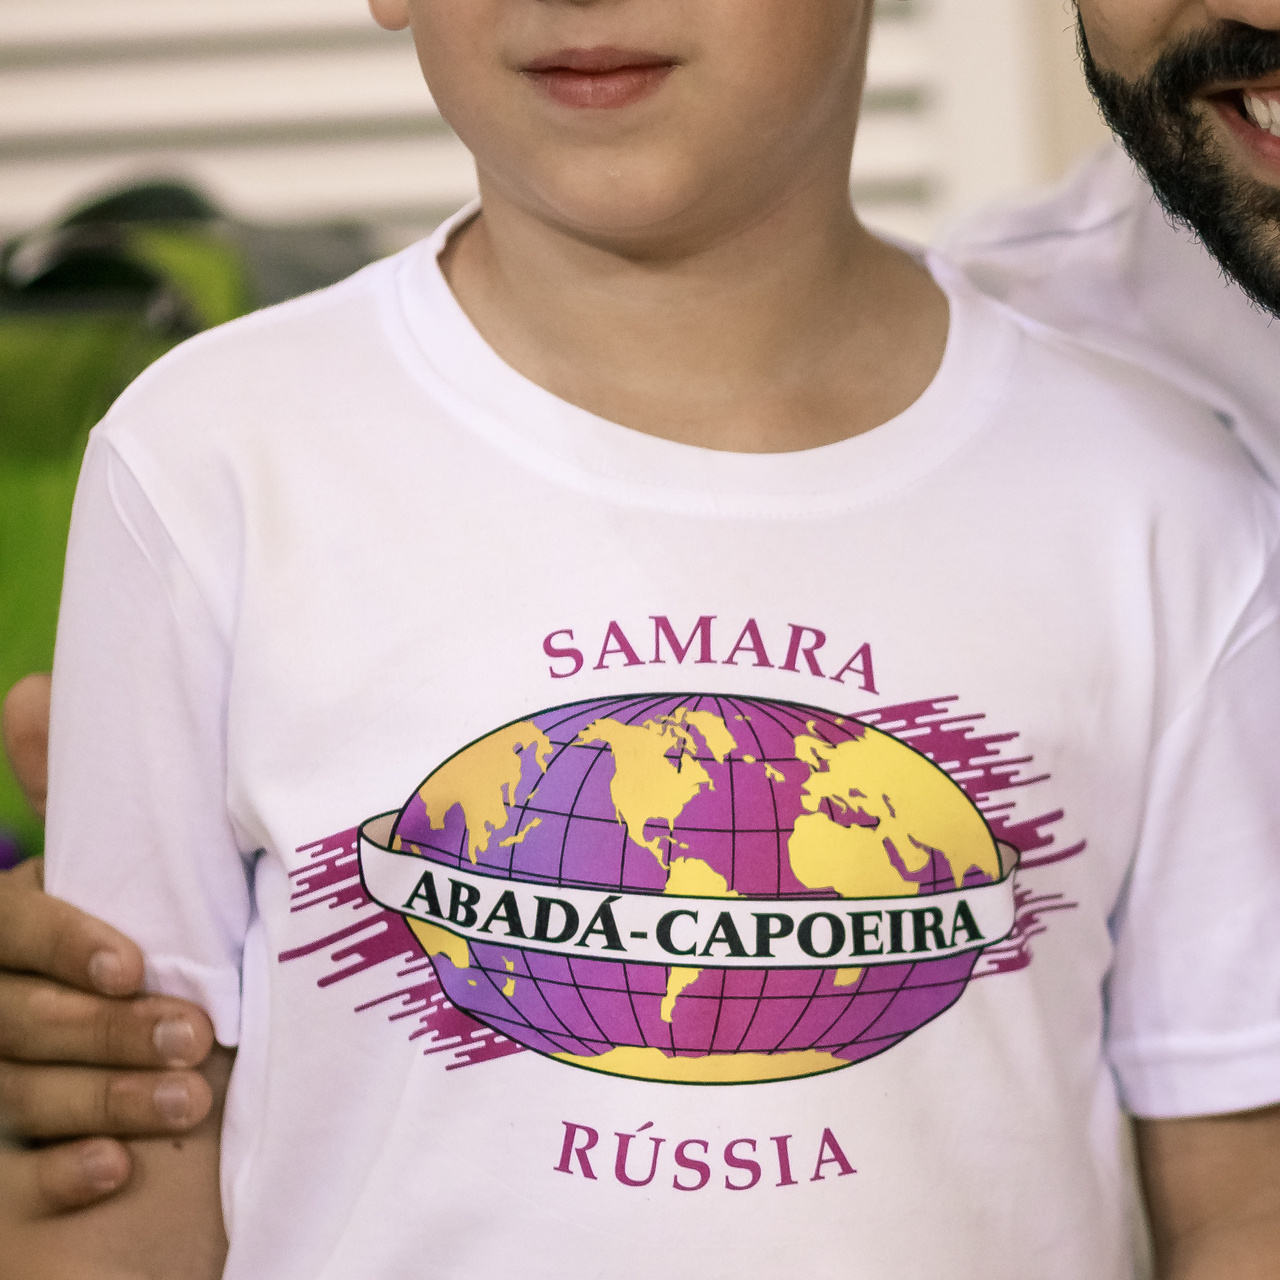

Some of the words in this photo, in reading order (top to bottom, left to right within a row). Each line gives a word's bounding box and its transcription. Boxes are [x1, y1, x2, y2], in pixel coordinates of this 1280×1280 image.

[542, 615, 880, 695] SAMARA
[401, 870, 986, 960] ABADÁ-CAPOEIRA
[552, 1120, 858, 1193] RÚSSIA
